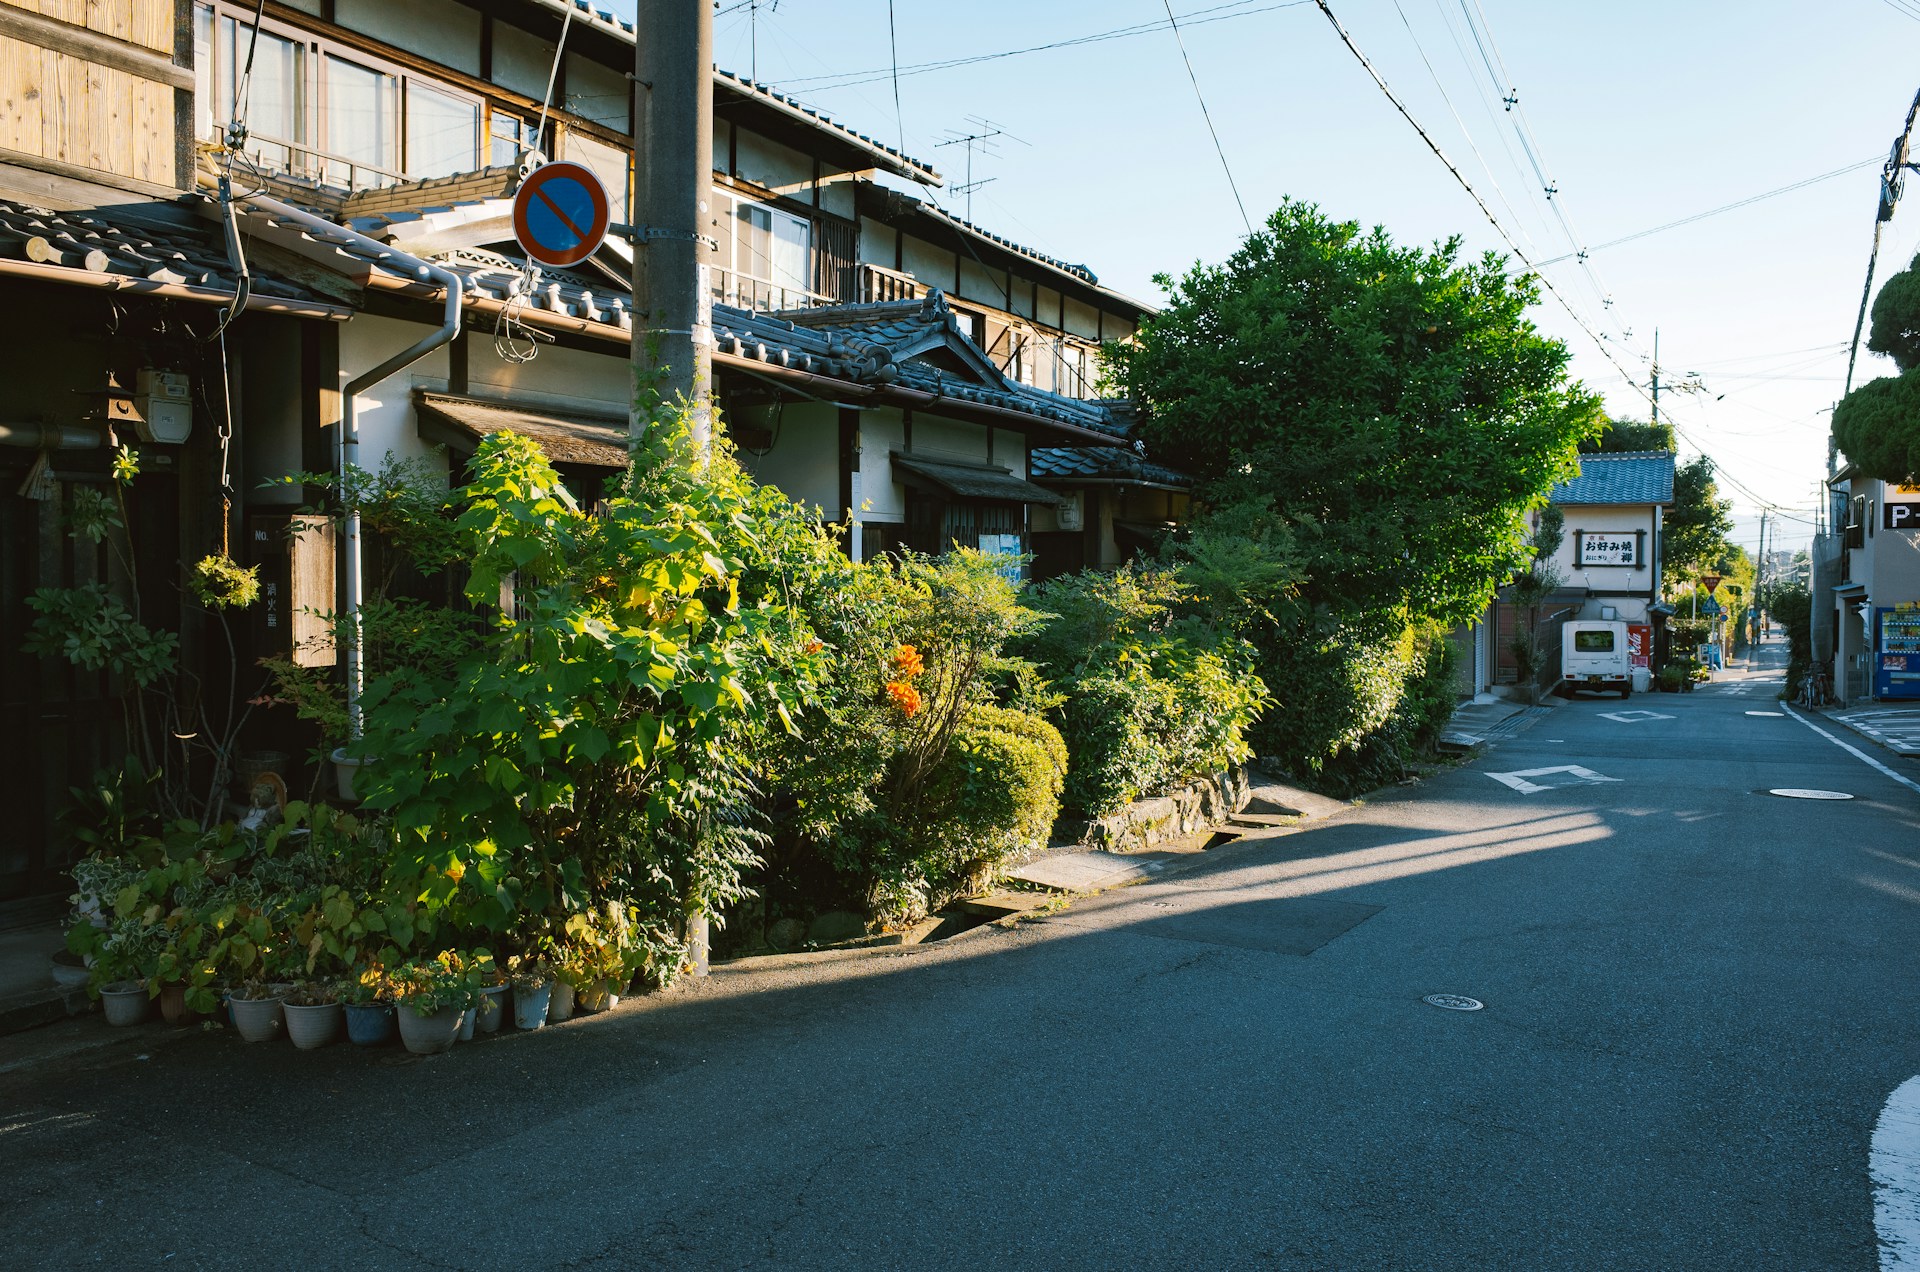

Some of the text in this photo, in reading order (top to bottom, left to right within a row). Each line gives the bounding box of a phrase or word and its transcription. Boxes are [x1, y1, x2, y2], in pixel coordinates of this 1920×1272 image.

[1892, 505, 1910, 528] P
[1585, 541, 1632, 552] お好み焼
[267, 582, 277, 627] 消火器
